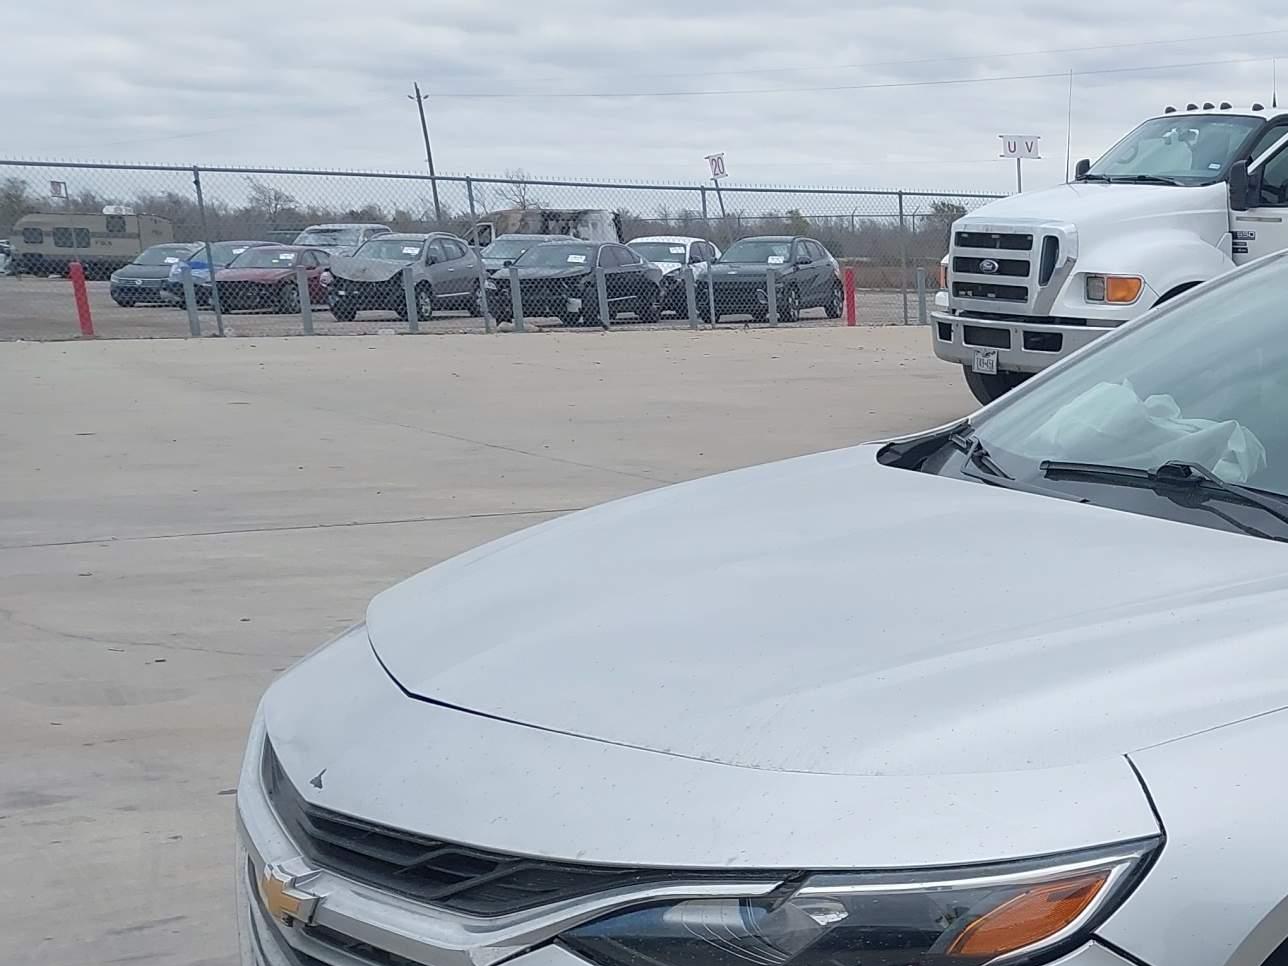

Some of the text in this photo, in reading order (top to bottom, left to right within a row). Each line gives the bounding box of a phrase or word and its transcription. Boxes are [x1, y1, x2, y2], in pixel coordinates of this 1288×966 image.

[1007, 140, 1034, 153] U V
[711, 156, 725, 176] 20
